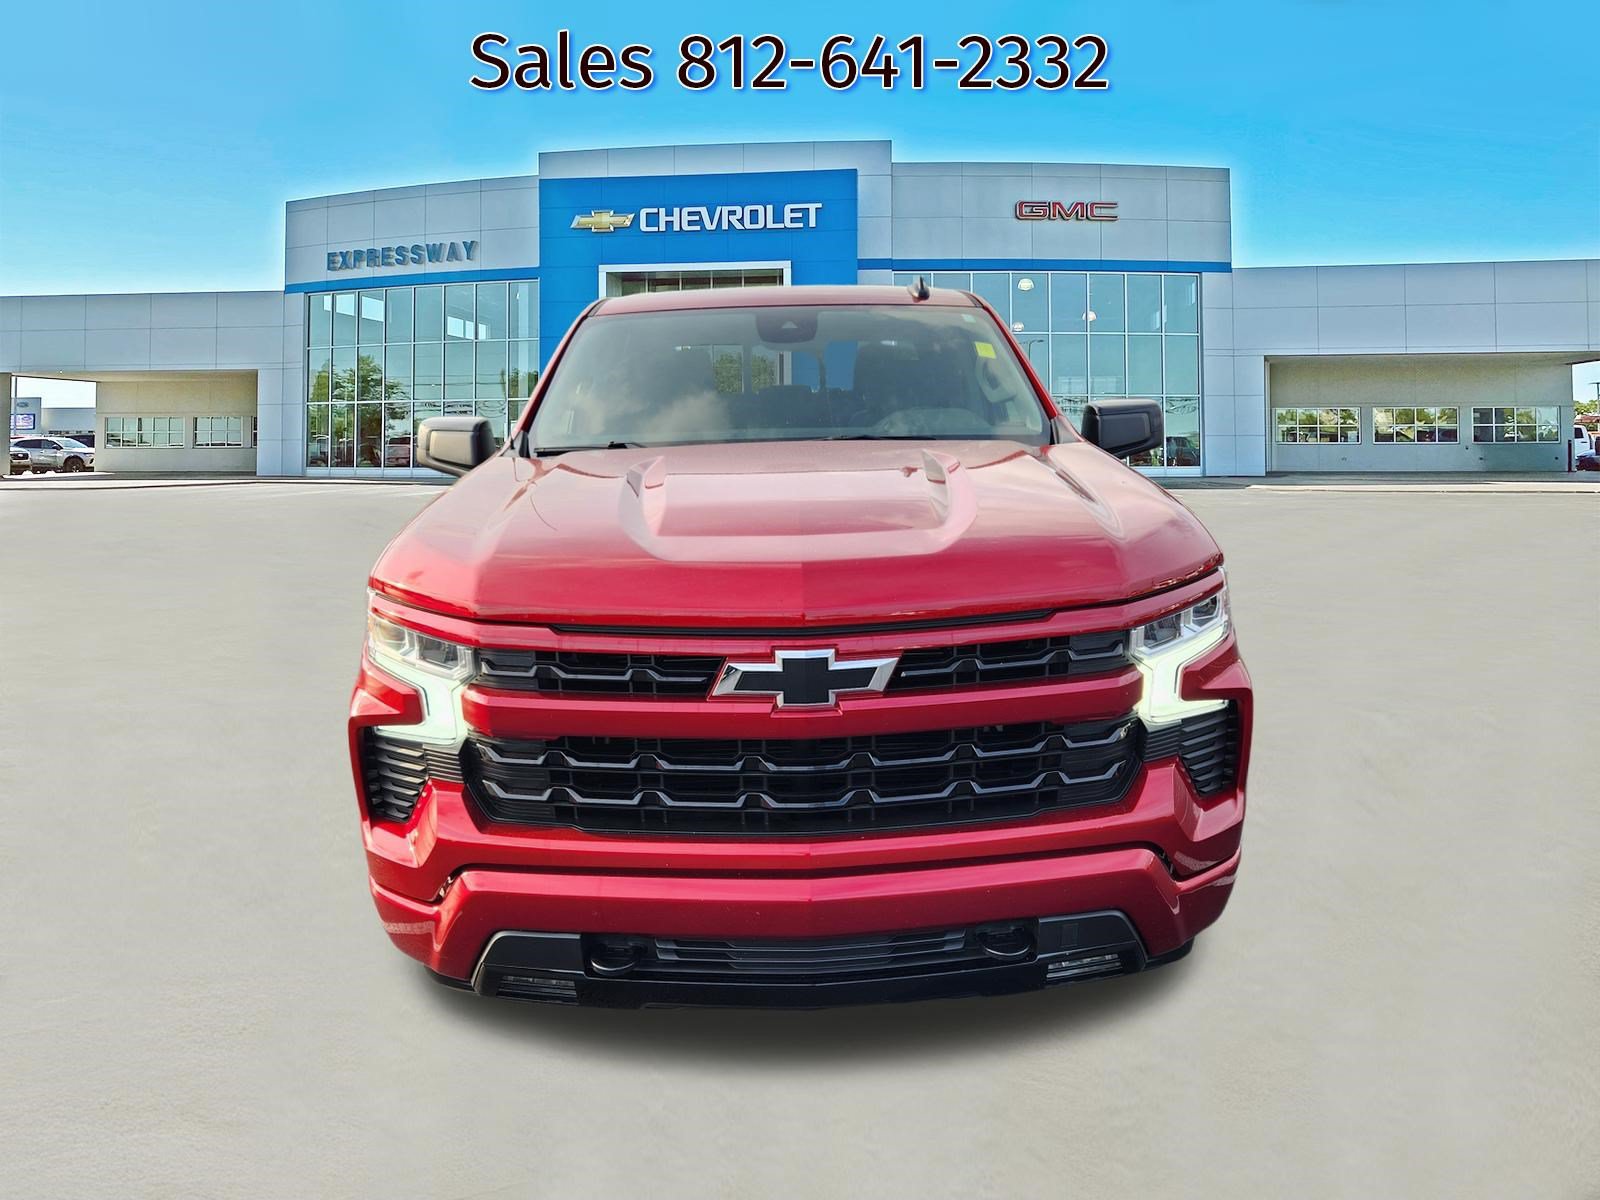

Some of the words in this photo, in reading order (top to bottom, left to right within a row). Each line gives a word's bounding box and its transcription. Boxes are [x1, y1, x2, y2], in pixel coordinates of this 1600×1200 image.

[639, 202, 822, 232] CHEVROLET
[1015, 200, 1119, 221] GMC
[327, 240, 479, 271] EXPRESSWAY
